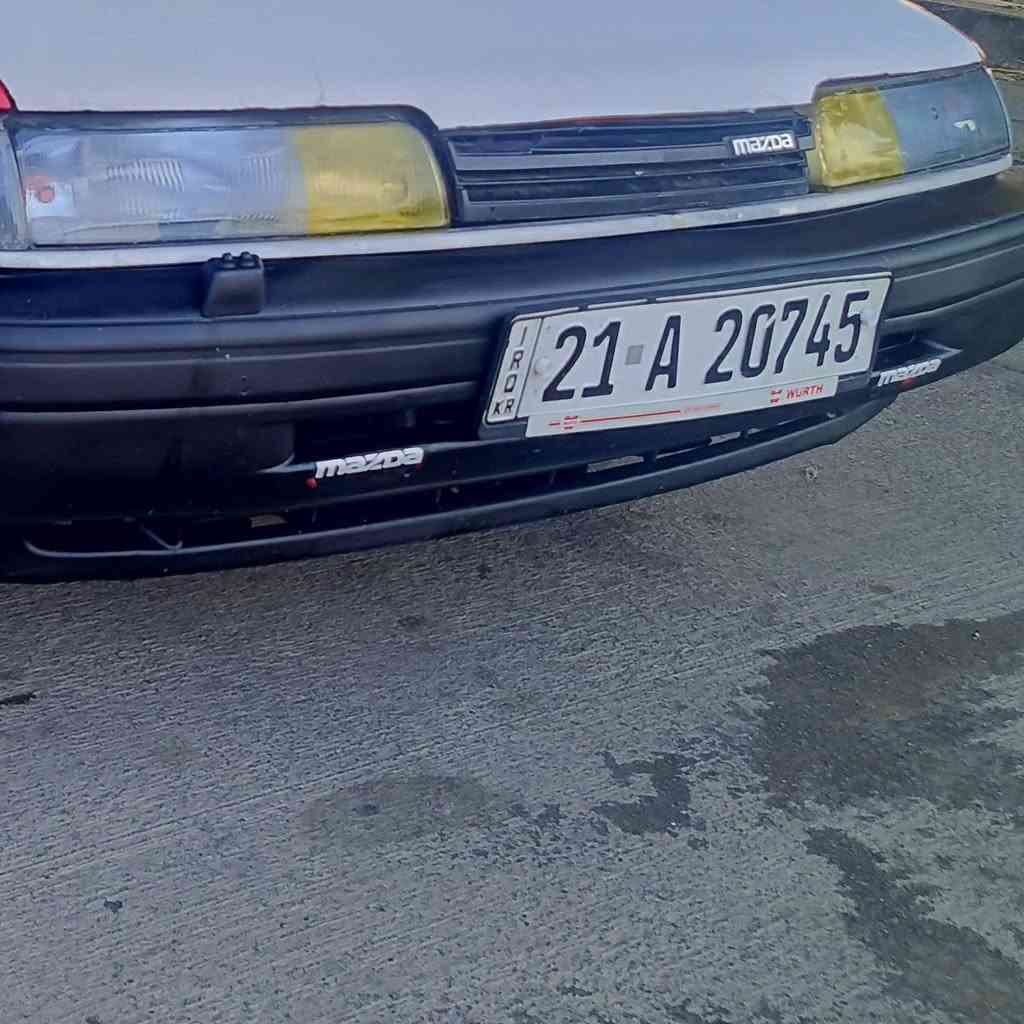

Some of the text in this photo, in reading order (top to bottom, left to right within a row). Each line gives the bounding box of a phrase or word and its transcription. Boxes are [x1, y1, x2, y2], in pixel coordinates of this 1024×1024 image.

[541, 290, 871, 403] 21 A 20745
